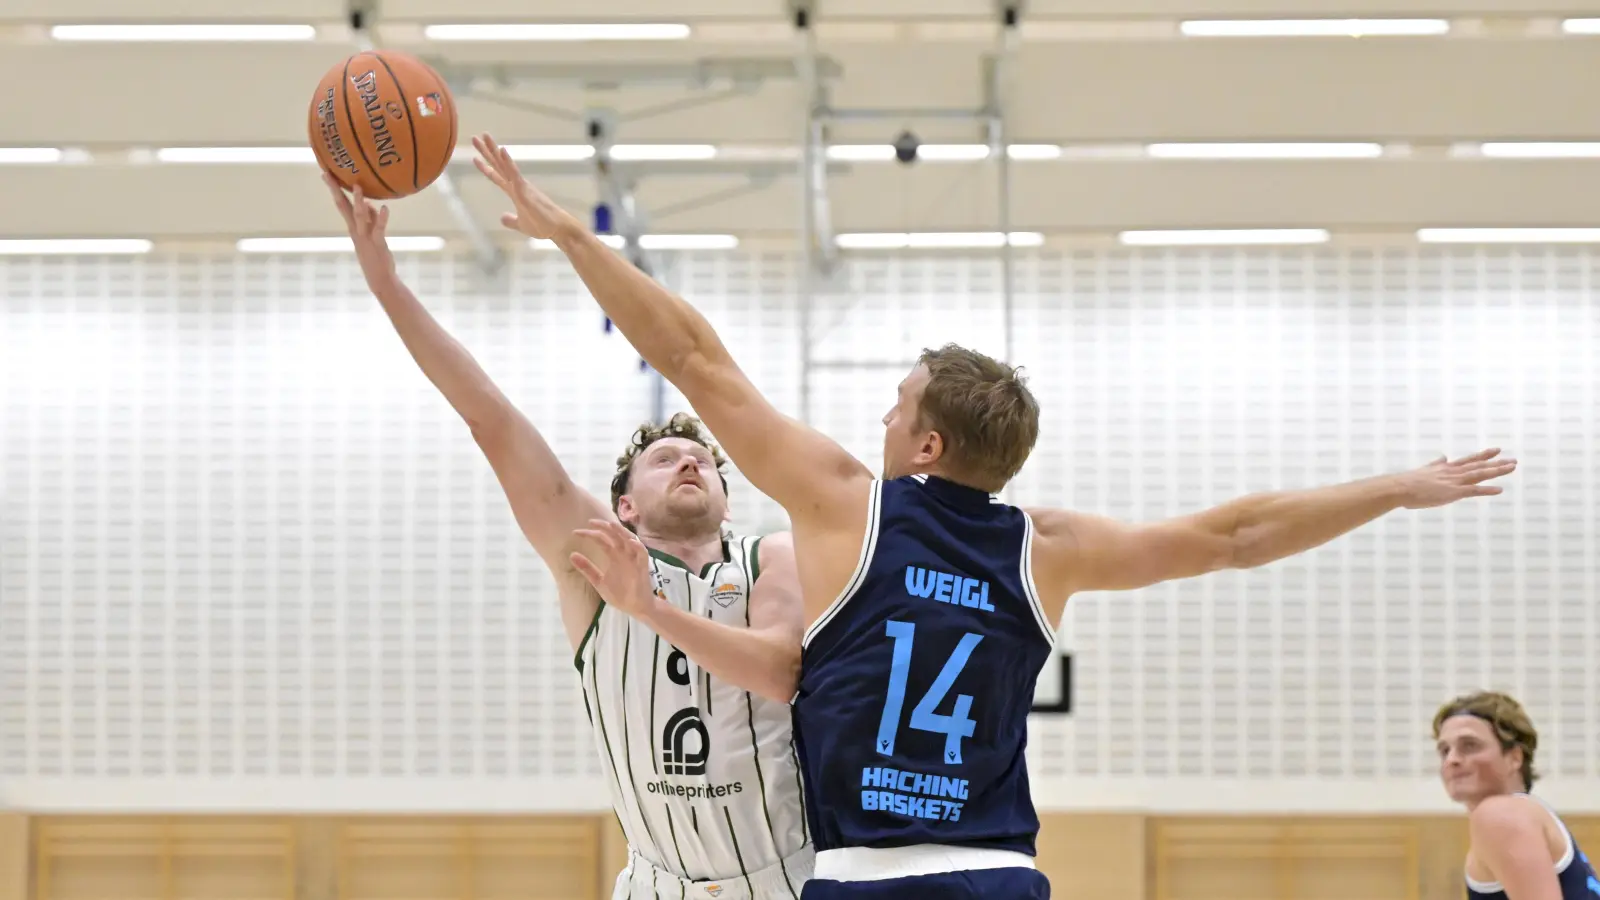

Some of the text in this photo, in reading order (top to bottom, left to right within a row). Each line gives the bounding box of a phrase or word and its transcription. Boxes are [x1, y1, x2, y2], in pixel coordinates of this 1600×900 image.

[325, 87, 360, 174] PRECISION
[350, 70, 402, 168] SPALDING
[904, 565, 995, 613] WEIGL
[876, 619, 985, 765] 14
[861, 767, 969, 800] HACHING
[861, 790, 964, 822] BASKETS
